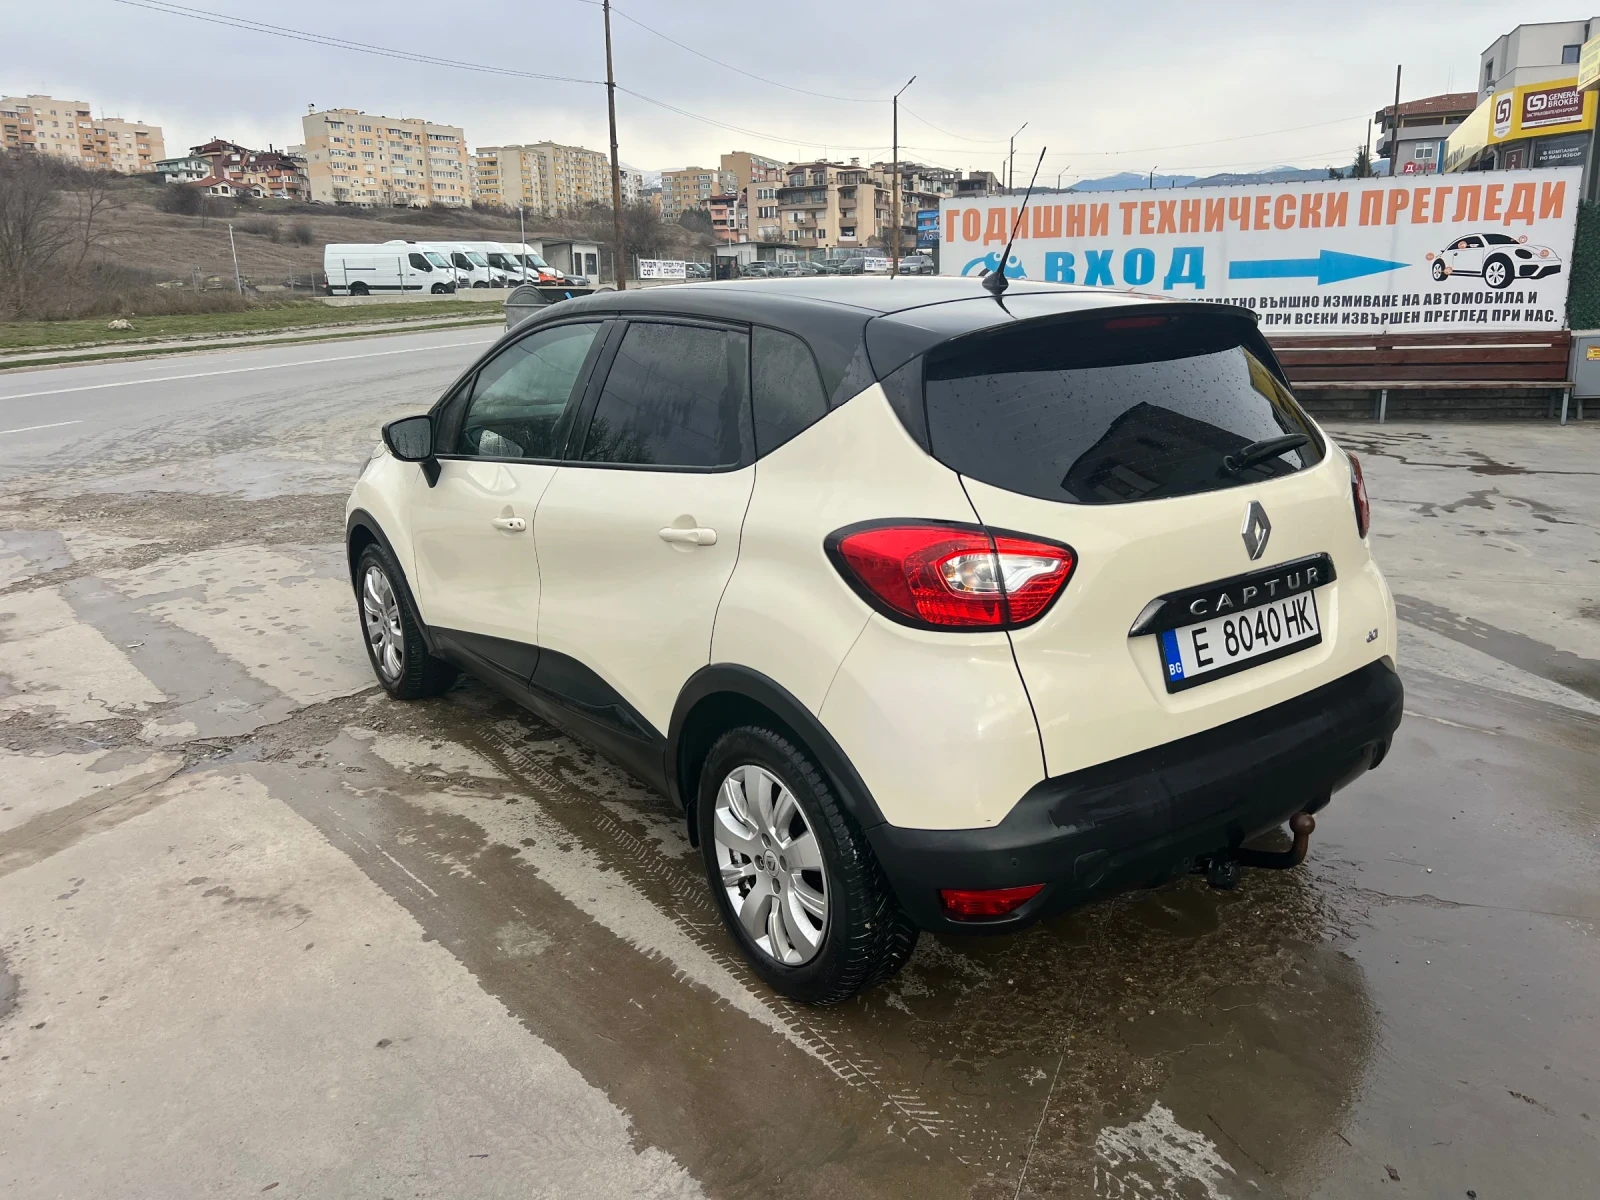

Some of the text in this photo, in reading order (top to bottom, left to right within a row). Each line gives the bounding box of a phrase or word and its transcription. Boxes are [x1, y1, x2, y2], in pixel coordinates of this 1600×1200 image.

[1548, 91, 1580, 101] GENERAL
[1548, 97, 1579, 108] BROKER
[945, 181, 1566, 246] ГОДИШНИ ТЕХНИЧЕСКИ ПРЕГЛЕДИ
[1044, 246, 1206, 290] ВХОД
[1259, 295, 1320, 309] ВЪНШНО
[1322, 294, 1398, 308] ИЗМИВАНЕ
[1401, 293, 1420, 307] НА
[1423, 291, 1524, 306] АВТОМОБИЛА
[1528, 291, 1538, 304] И
[1265, 313, 1292, 325] ПРИ
[1295, 312, 1338, 325] ВСЕКИ
[1341, 311, 1421, 325] ИЗВЪРШЕН
[1423, 309, 1488, 324] ПРЕГЛЕД
[1491, 309, 1521, 322] ПРИ
[1525, 309, 1558, 323] НАС.
[1189, 567, 1320, 616] CAPTUR
[1190, 595, 1315, 668] E 8040 HK
[1168, 662, 1183, 676] BG
